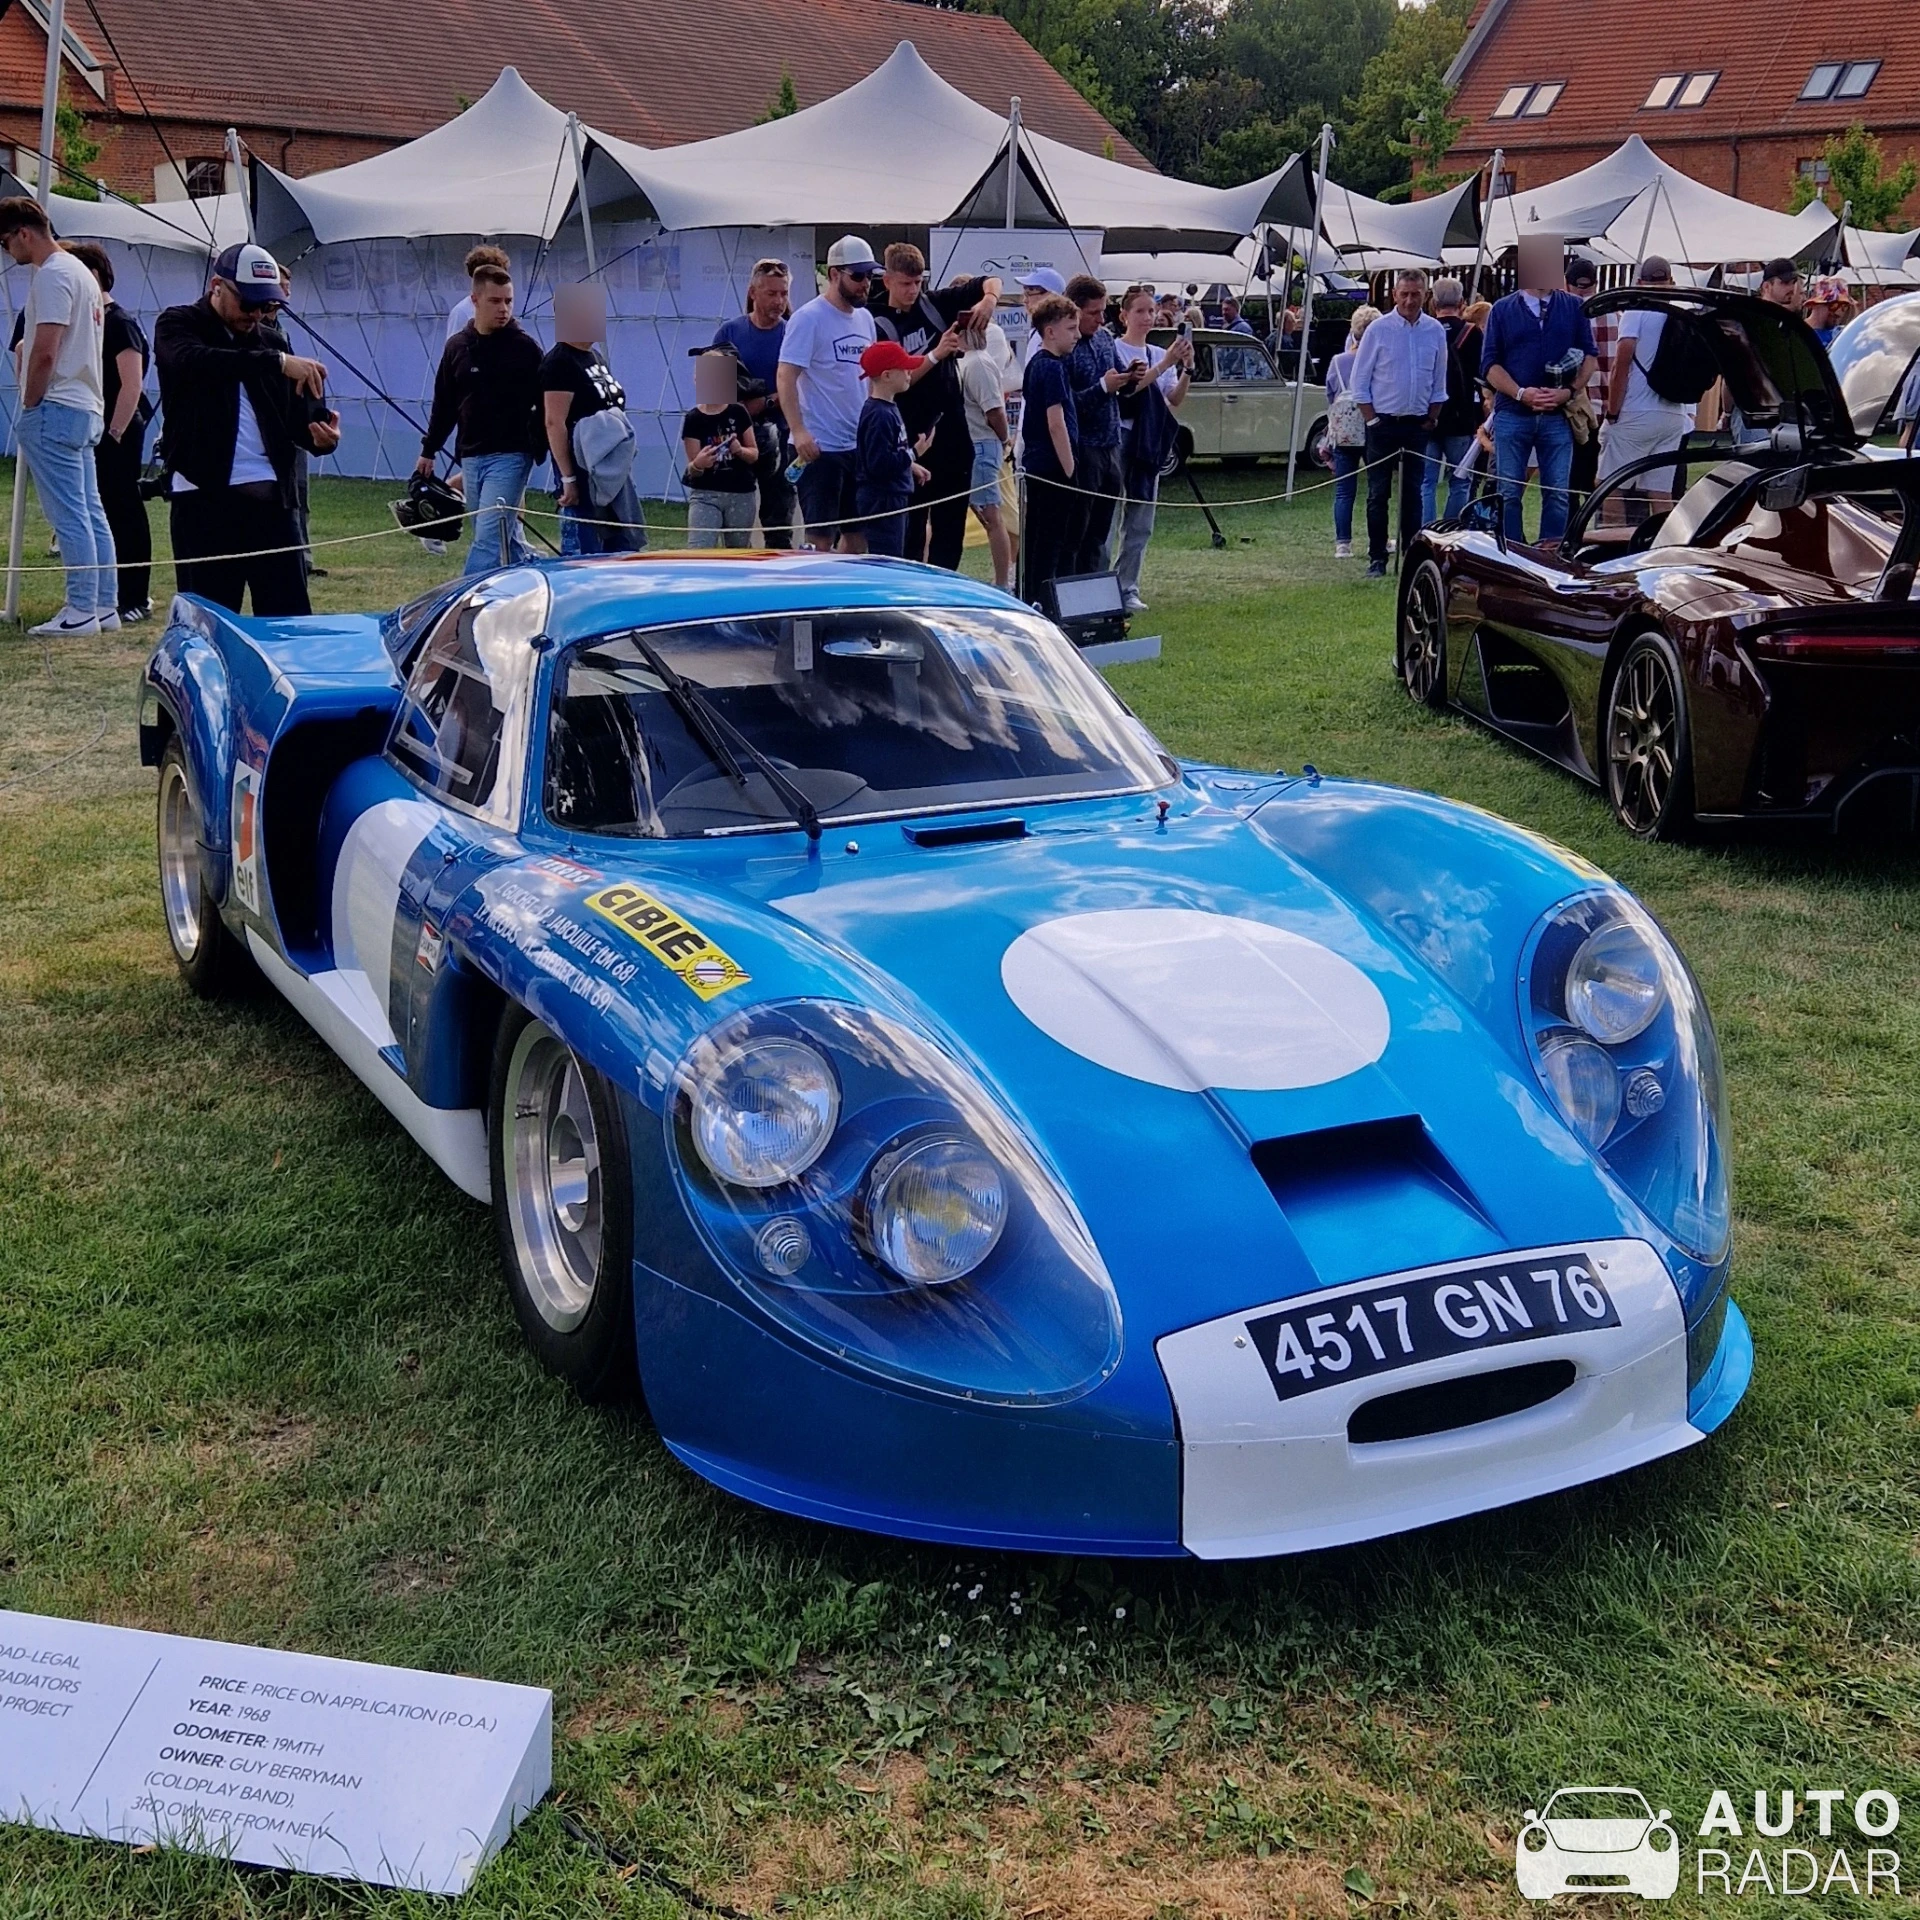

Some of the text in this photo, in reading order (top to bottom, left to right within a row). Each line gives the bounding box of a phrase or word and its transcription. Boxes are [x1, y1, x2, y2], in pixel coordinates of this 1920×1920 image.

[236, 864, 255, 907] elf
[502, 883, 541, 914] GUICHET
[545, 914, 602, 958] JABOUILLE
[611, 958, 640, 986] 68)
[484, 909, 523, 945] NICOLAS
[590, 985, 615, 1016] 69)
[1274, 1265, 1607, 1380] 4517 GN 76
[3, 1695, 73, 1718] PROJECT
[188, 1698, 271, 1723] YEAR: 1968
[199, 1675, 498, 1733] PRICE: PRICE ON APPLICATION (P.O.A.)
[173, 1722, 325, 1757] ODOMETER: 19MTH
[144, 1770, 295, 1809] (COLDPLAY BAND),
[159, 1746, 363, 1790] OWNER: GUY BERRYMAN
[131, 1795, 330, 1839] 3RD OWNER FROM NEW
